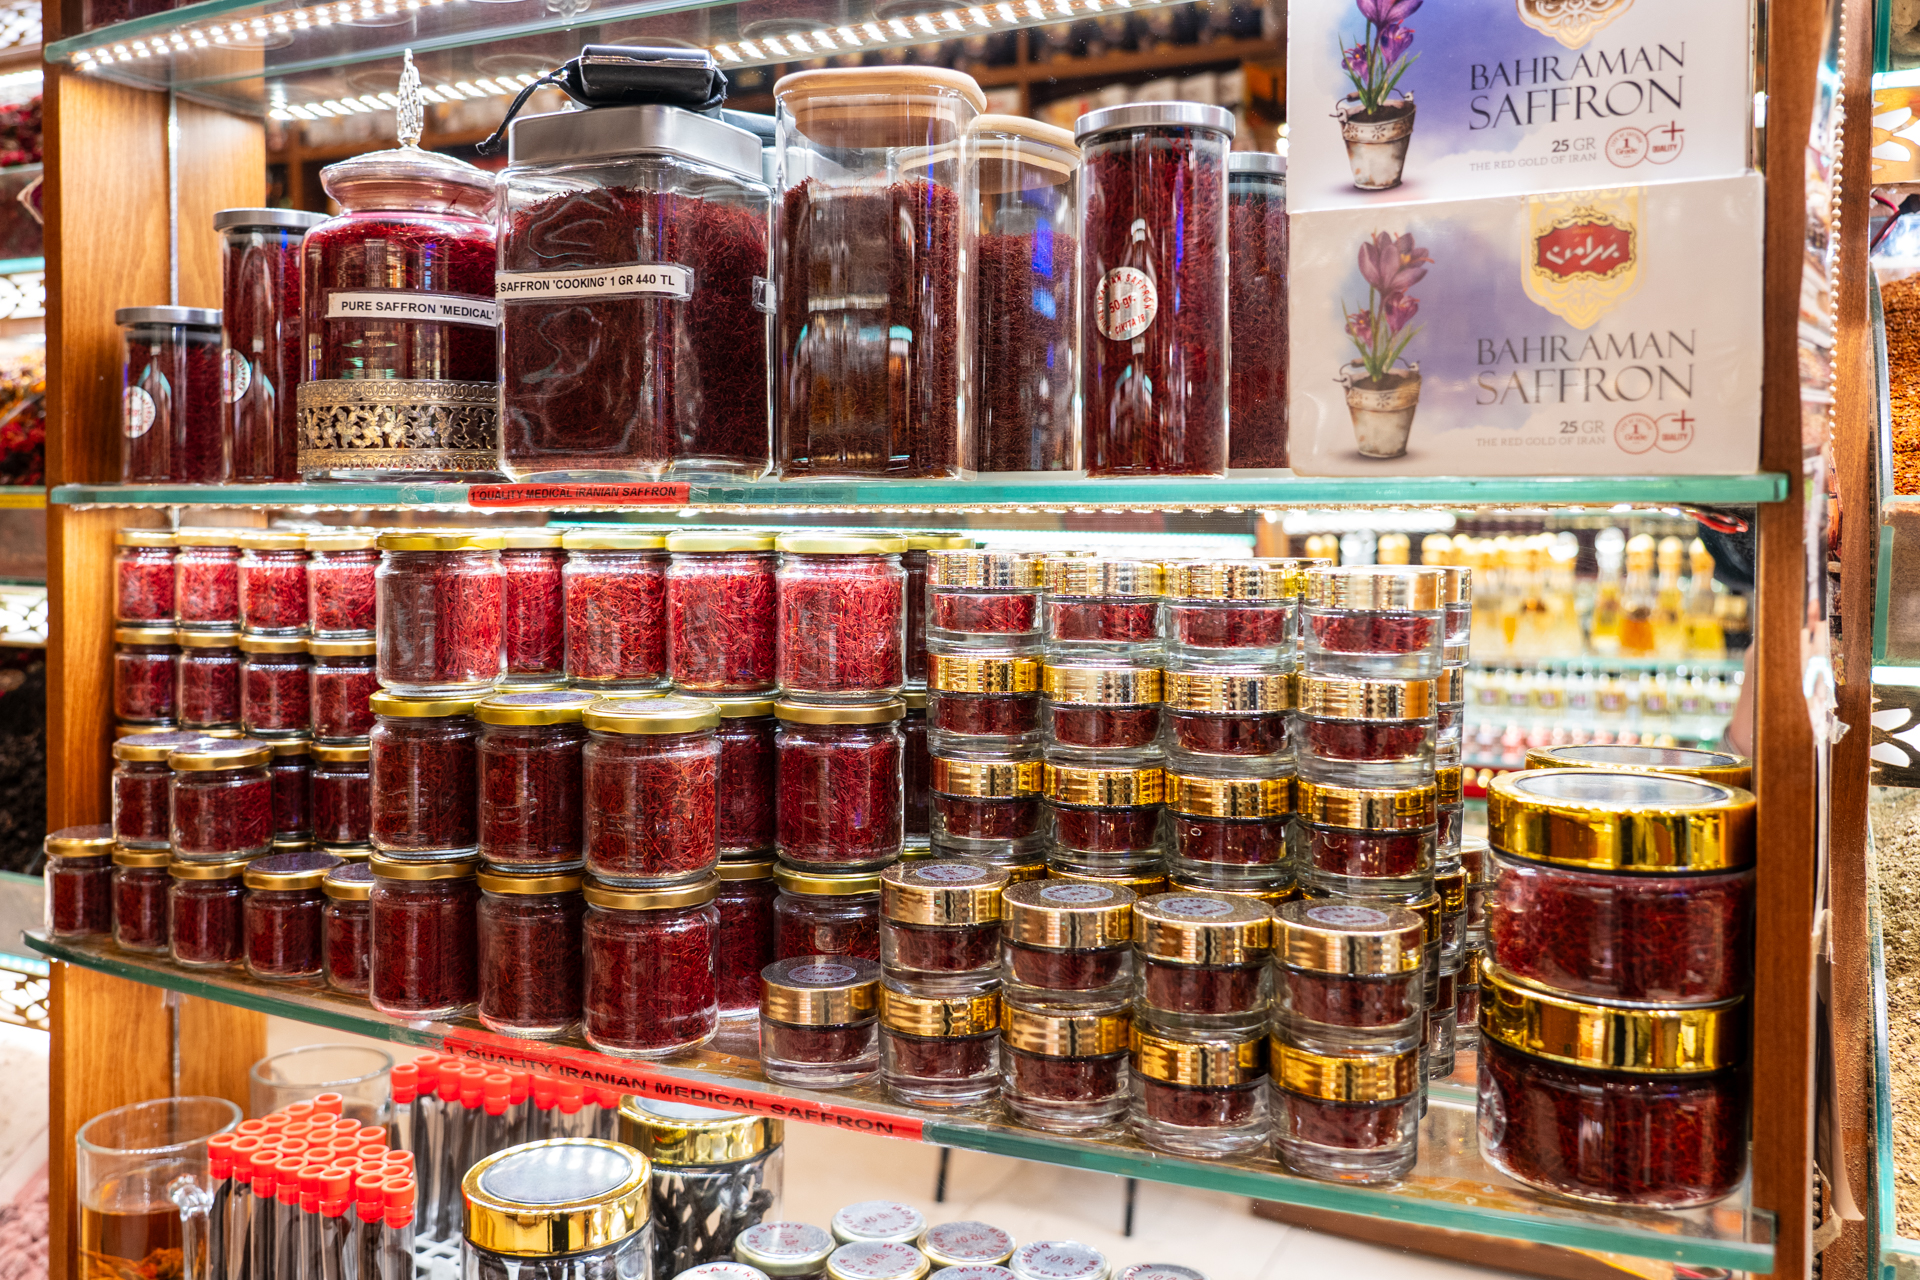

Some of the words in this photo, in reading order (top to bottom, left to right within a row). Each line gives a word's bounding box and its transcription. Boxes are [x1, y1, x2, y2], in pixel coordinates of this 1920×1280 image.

[1470, 40, 1685, 92] BAHRAMAN
[1469, 75, 1683, 131] SAFFRON
[1551, 139, 1569, 153] 25
[1573, 137, 1596, 151] GR
[1615, 147, 1638, 155] Grade
[1623, 138, 1629, 148] 1
[1652, 144, 1677, 153] QUALITY
[1469, 162, 1491, 171] THE
[1494, 160, 1515, 170] RED
[1518, 157, 1548, 167] GOLD
[1550, 155, 1566, 165] OF
[1569, 152, 1597, 163] IRAN
[500, 280, 550, 292] SAFFRON
[553, 277, 607, 289] 'COOKING'
[610, 277, 615, 286] 1
[618, 275, 633, 286] GR
[635, 274, 656, 285] 440
[660, 274, 675, 286] TL
[1126, 274, 1151, 309] SAFFRON
[342, 301, 372, 311] PURE
[376, 301, 436, 314] SAFFRON
[440, 305, 494, 320] 'MEDICAL'
[1108, 299, 1120, 313] 50
[1476, 328, 1697, 365] BAHRAMAN
[1475, 362, 1694, 405] SAFFRON
[1559, 420, 1578, 434] 25
[1581, 420, 1604, 434] GR
[1633, 424, 1638, 434] 1
[1475, 438, 1497, 447] THE
[1500, 437, 1523, 446] RED
[1525, 437, 1556, 446] GOLD
[1558, 436, 1573, 445] OF
[1576, 436, 1605, 445] IRAN
[525, 488, 570, 499] MEDICAL
[575, 487, 619, 498] IRANIAN
[622, 486, 677, 497] SAFFRON
[560, 1066, 647, 1090] IRANIAN
[655, 1080, 762, 1111] MEDICAL
[770, 1103, 894, 1134] SAFFRON
